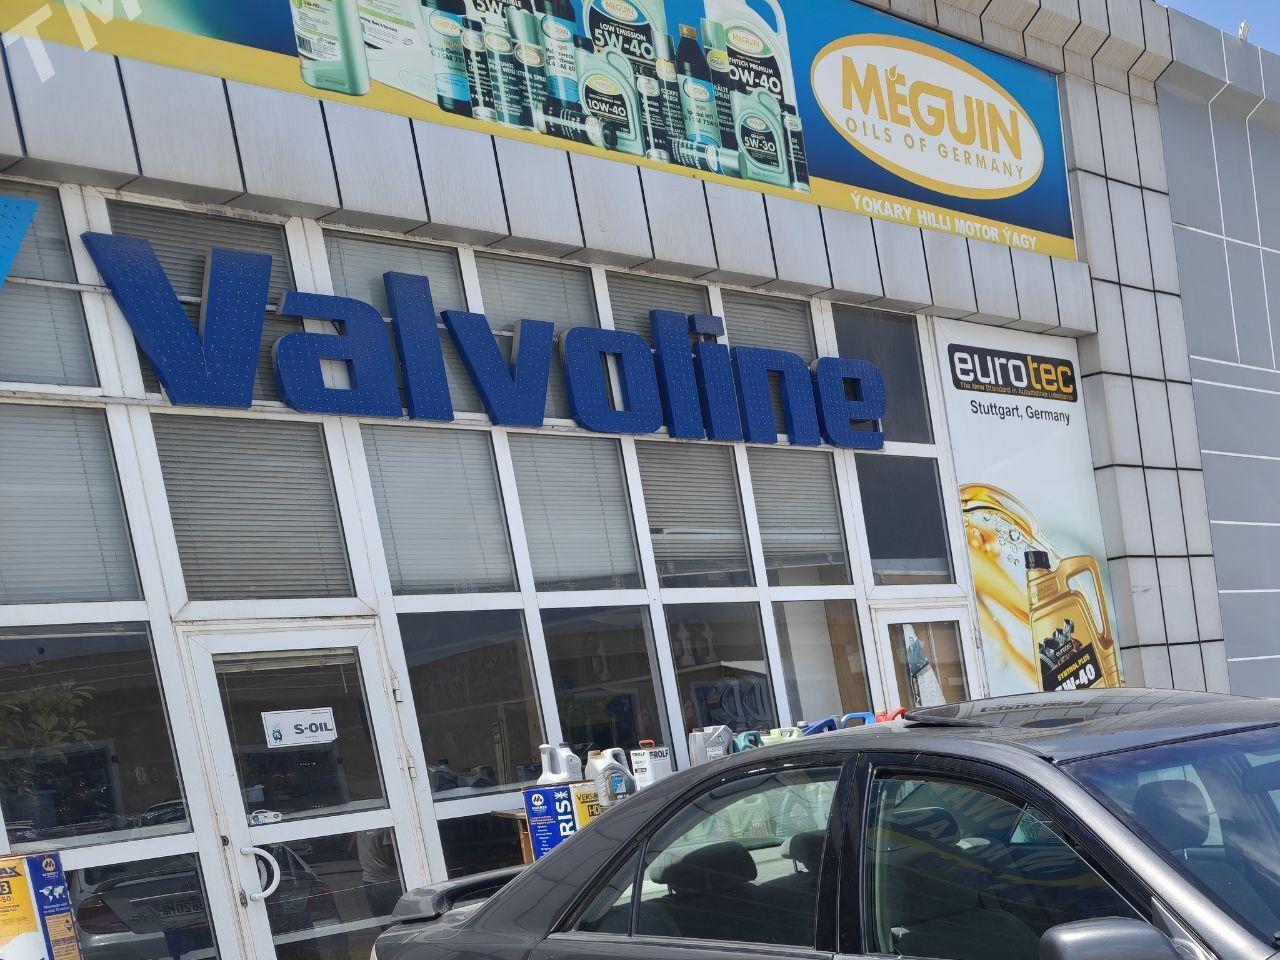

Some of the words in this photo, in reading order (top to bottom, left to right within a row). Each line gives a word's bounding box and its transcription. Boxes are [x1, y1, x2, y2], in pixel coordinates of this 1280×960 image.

[594, 28, 654, 60] 5W-40
[599, 22, 617, 34] LOW
[616, 26, 647, 42] EMISSION
[732, 33, 761, 49] MEGUIN
[587, 98, 627, 117] 10W-40
[743, 136, 776, 152] 5W-30
[845, 117, 895, 144] OILS
[903, 133, 927, 153] OF
[937, 142, 1024, 181] GERMANY
[850, 189, 914, 223] ÝOKARY
[916, 208, 953, 234] HILLI
[953, 216, 1001, 242] MOTOR
[1002, 226, 1038, 251] ÝAGY
[81, 231, 887, 452] Valvoline
[953, 351, 1074, 394] eurotec
[969, 399, 1023, 419] Stuttgart,
[1025, 405, 1070, 426] Germany
[293, 722, 335, 735] S-OIL
